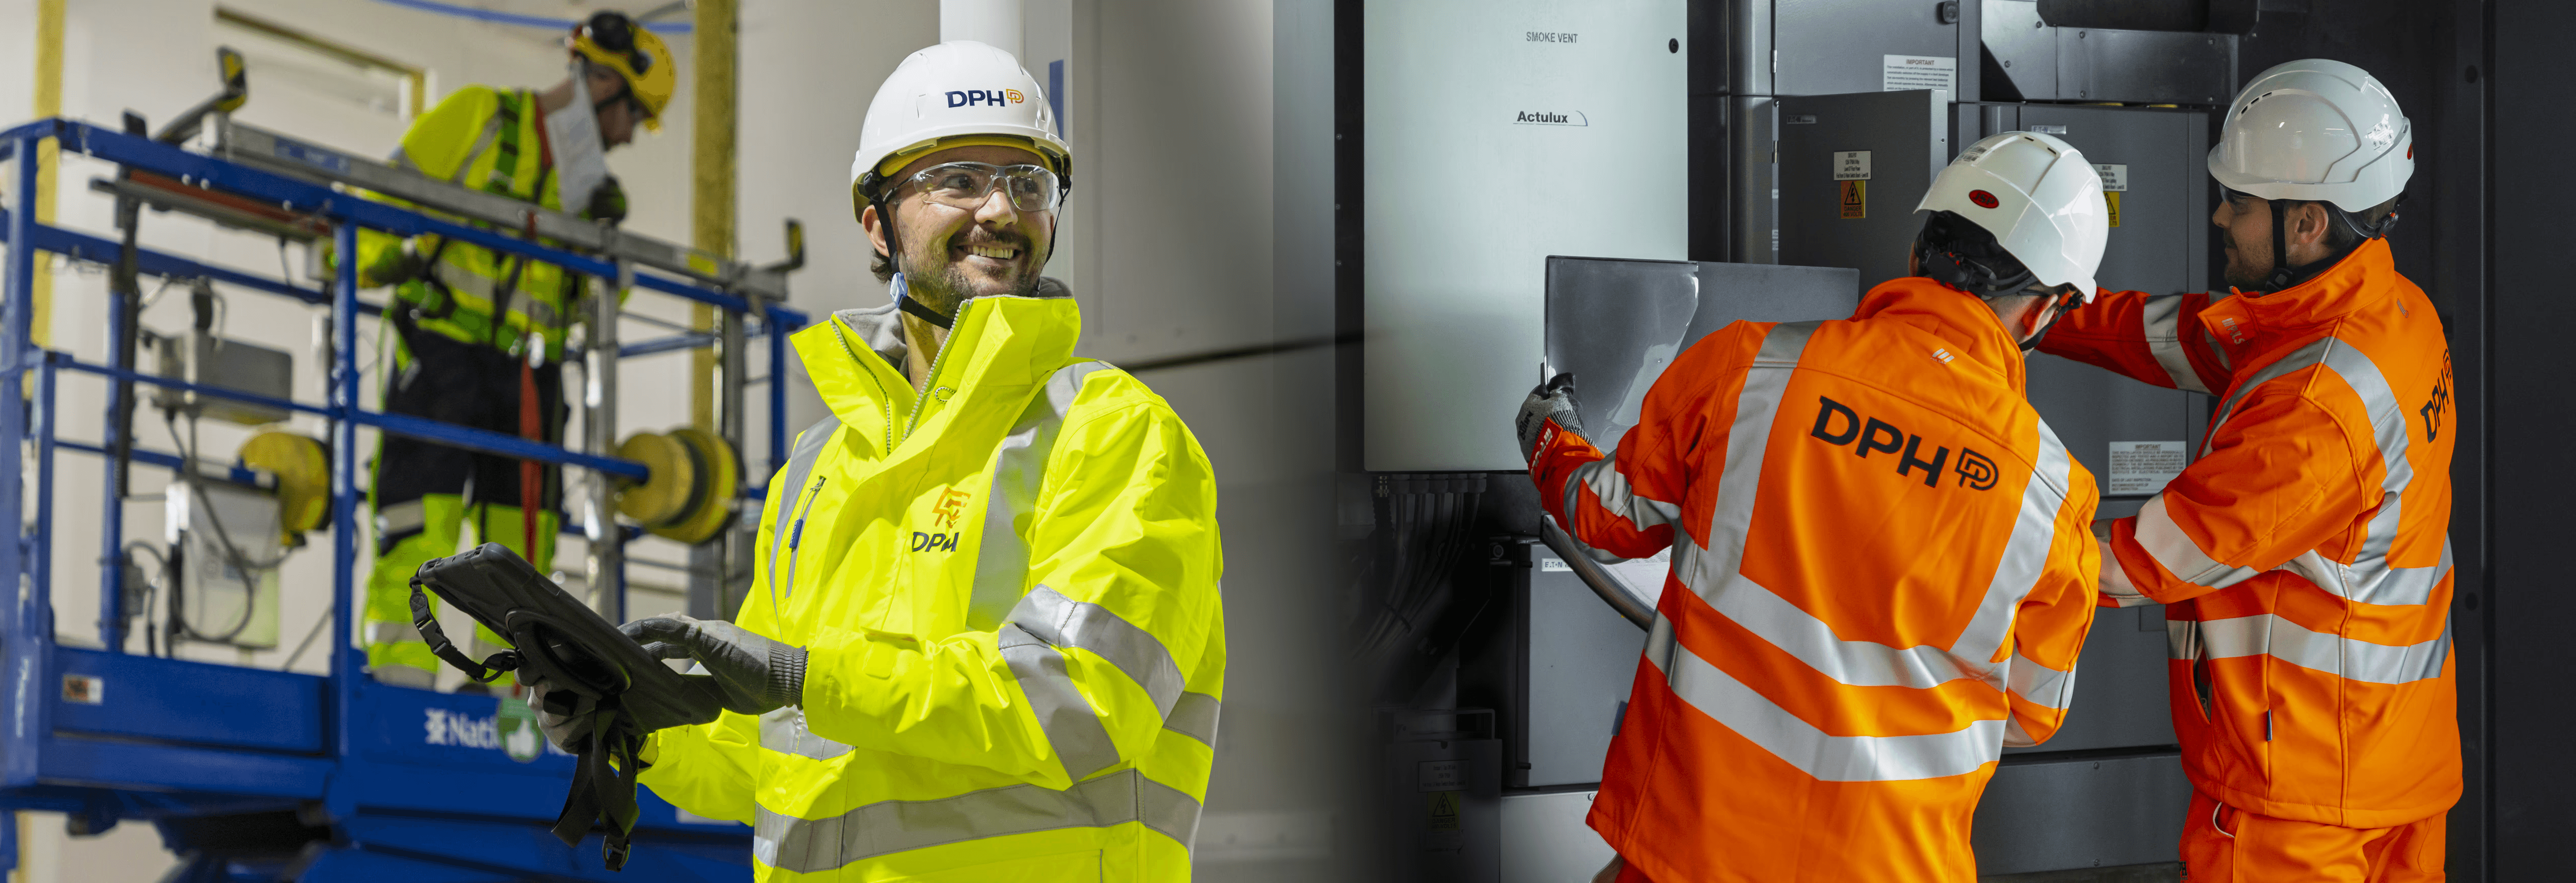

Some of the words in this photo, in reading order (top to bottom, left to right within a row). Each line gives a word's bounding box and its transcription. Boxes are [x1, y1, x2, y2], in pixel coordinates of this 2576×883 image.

[1526, 31, 1555, 42] SMOKE
[1558, 32, 1578, 43] VENT
[945, 90, 1005, 108] DPH
[1517, 111, 1569, 124] Actulux
[1973, 193, 1995, 205] JSP
[2420, 368, 2449, 444] DPH
[1811, 395, 1949, 488] DPH
[912, 531, 959, 553] DPH
